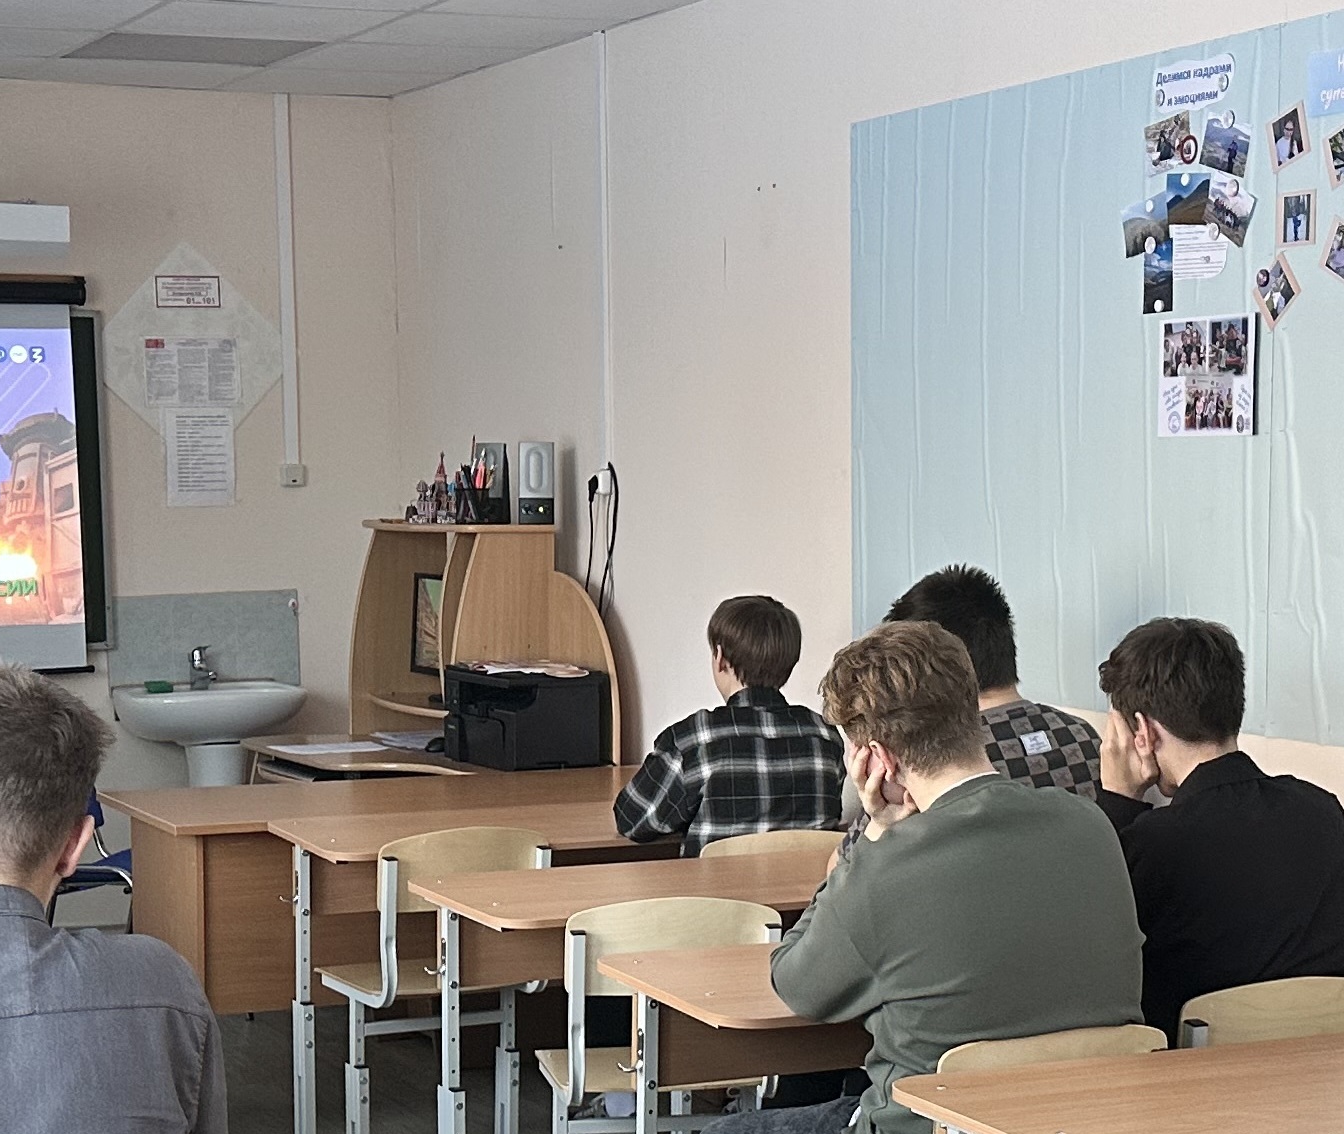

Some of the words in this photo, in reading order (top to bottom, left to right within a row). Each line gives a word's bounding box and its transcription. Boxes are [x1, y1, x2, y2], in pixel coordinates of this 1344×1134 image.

[1156, 69, 1191, 87] Делимся
[1193, 63, 1232, 79] кадрами
[1174, 90, 1218, 106] эмоциями
